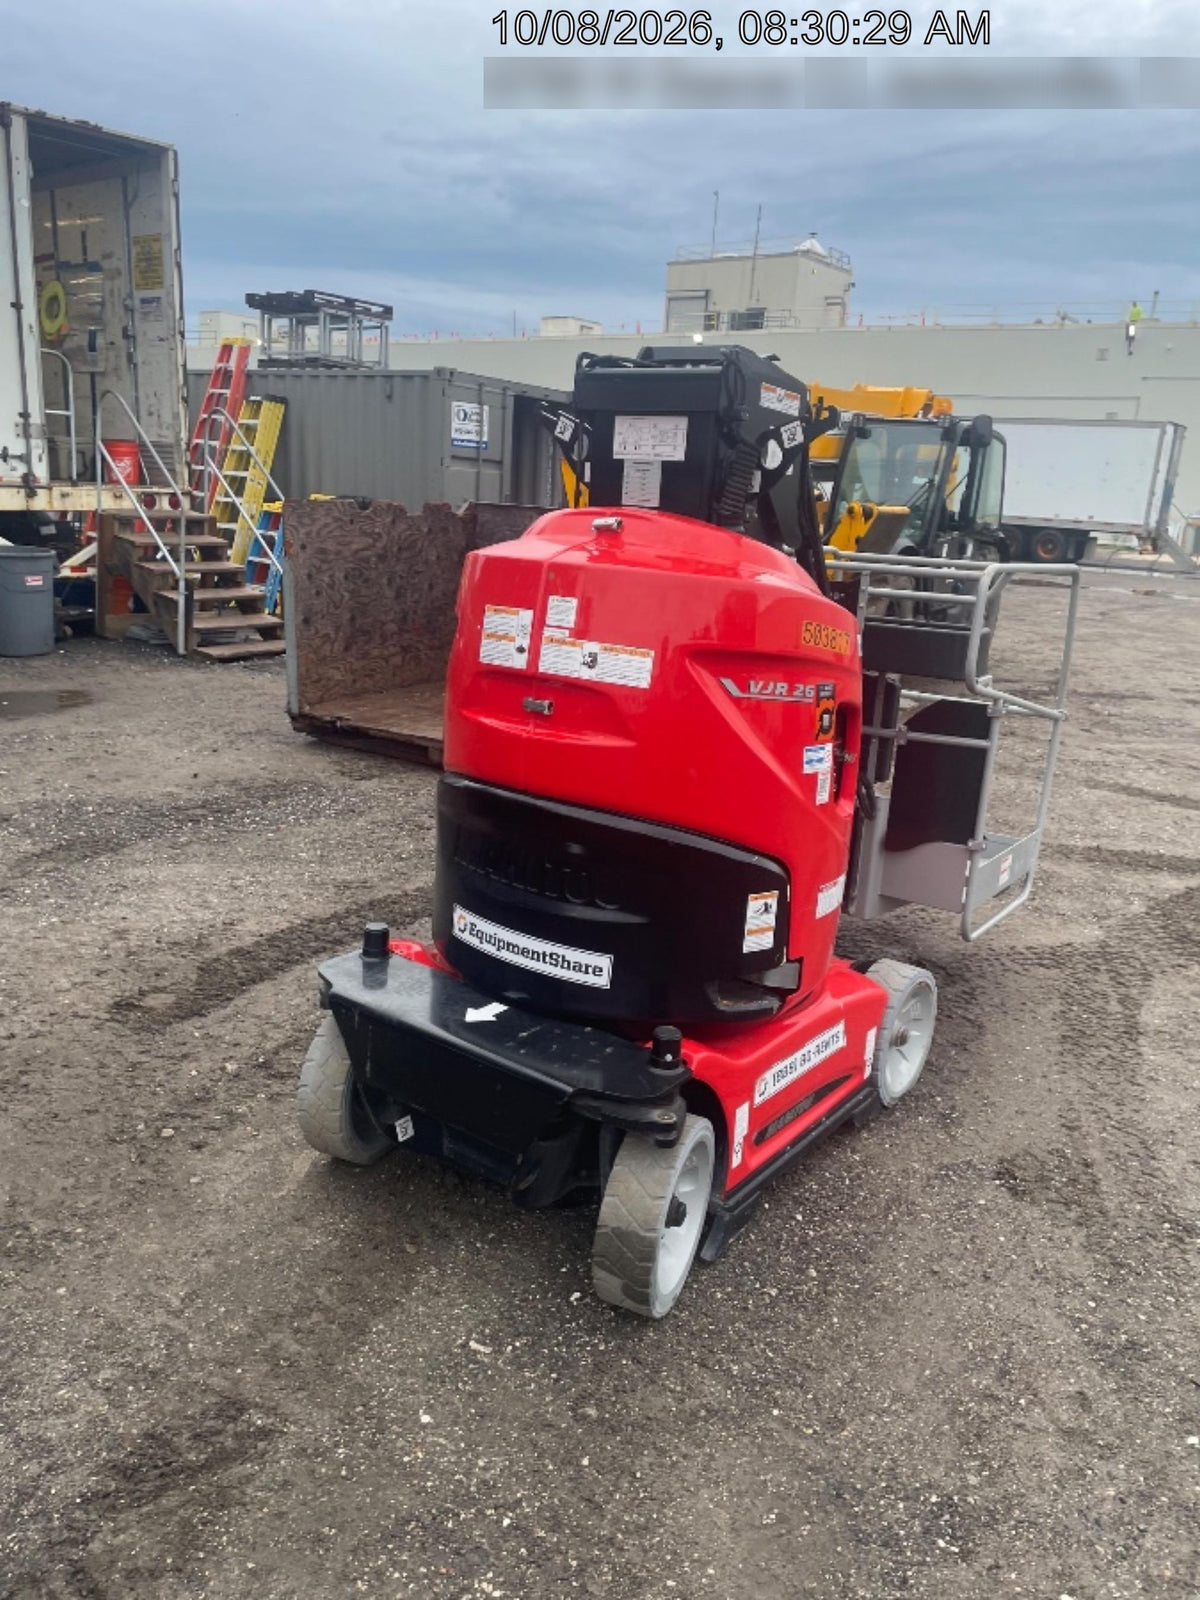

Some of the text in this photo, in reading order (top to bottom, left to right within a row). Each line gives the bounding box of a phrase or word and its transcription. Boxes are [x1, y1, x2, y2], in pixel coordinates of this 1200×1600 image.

[749, 680, 789, 696] VJR
[793, 683, 815, 698] 26
[468, 921, 604, 977] EquipmentShare
